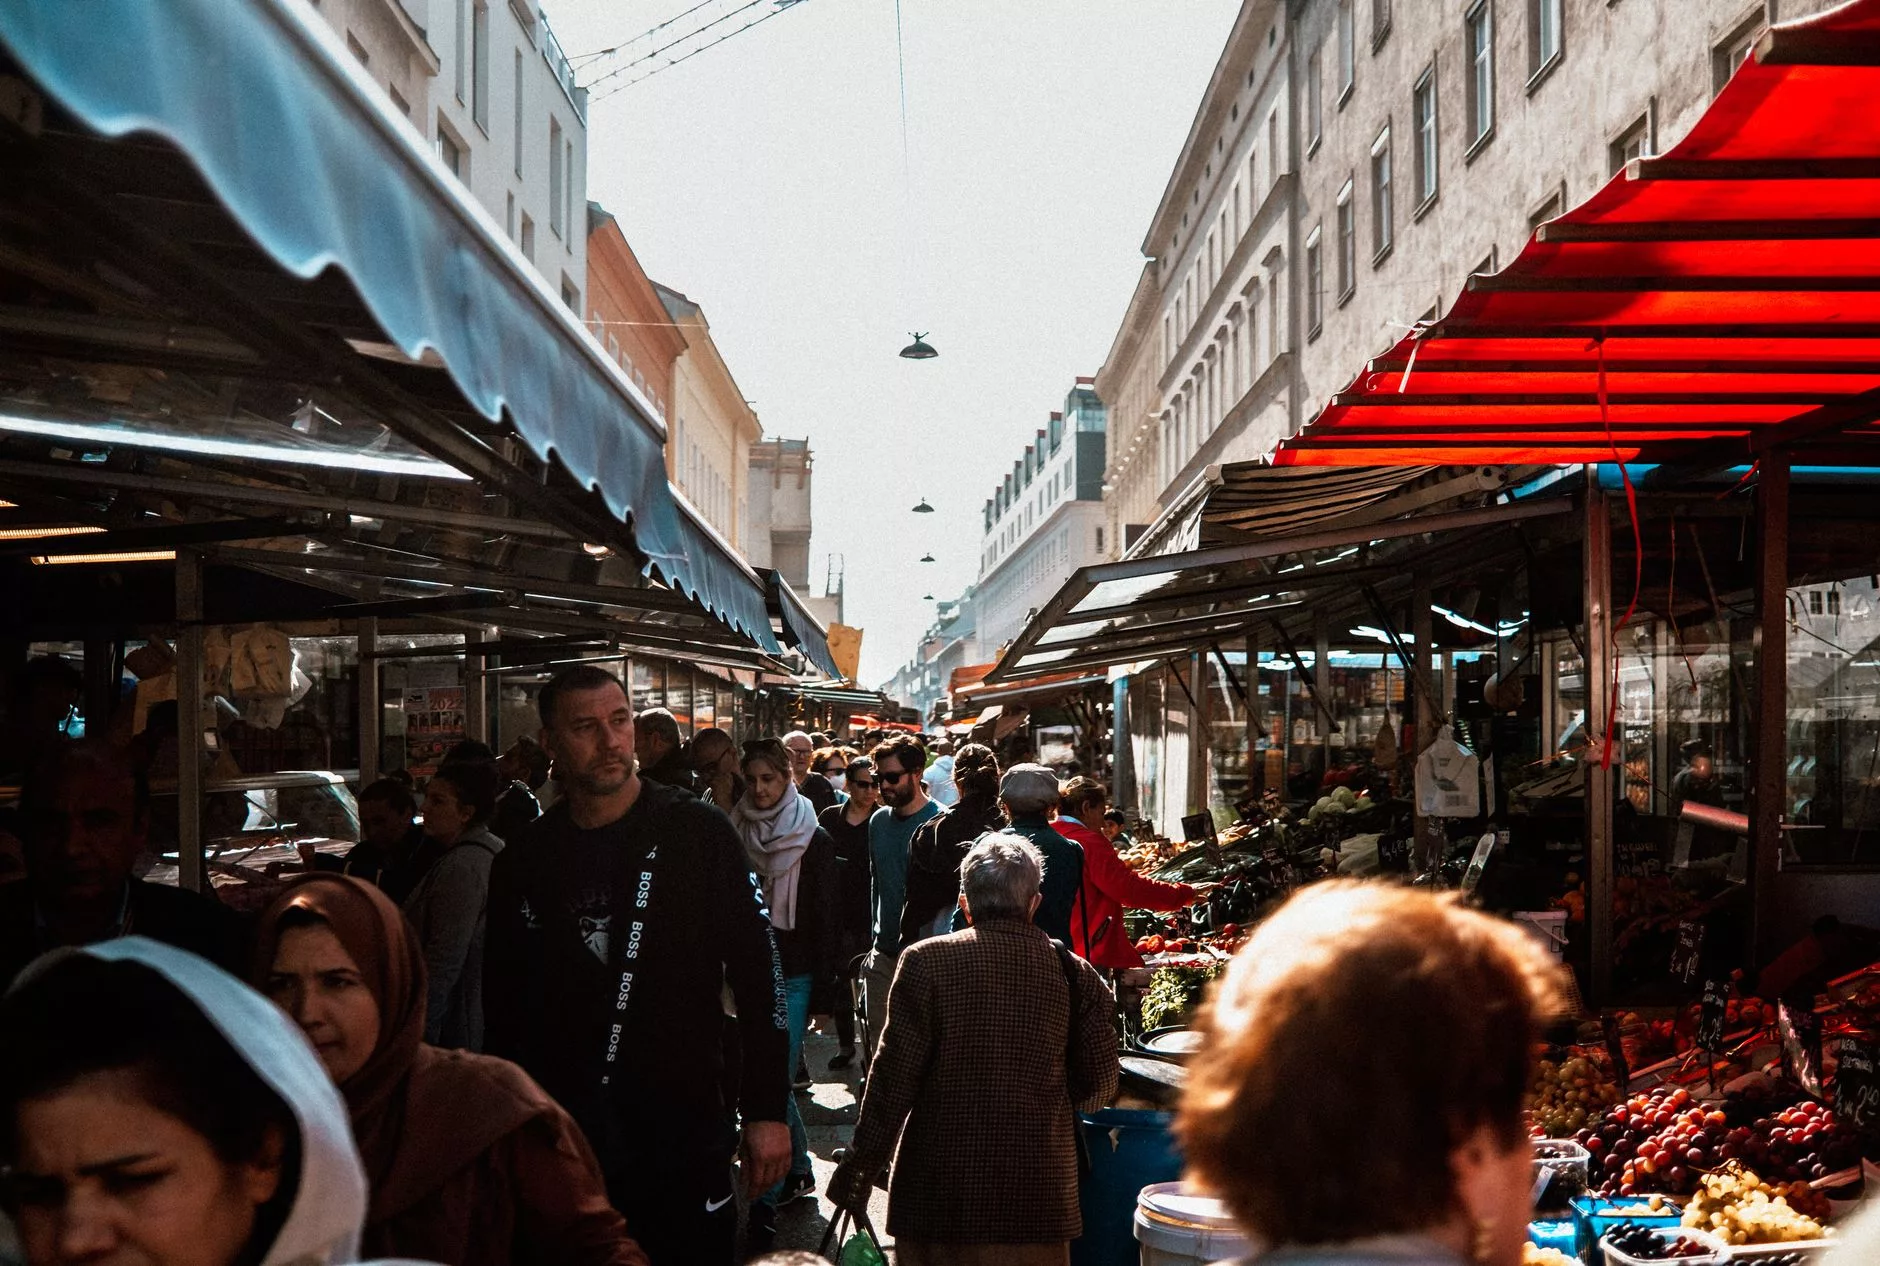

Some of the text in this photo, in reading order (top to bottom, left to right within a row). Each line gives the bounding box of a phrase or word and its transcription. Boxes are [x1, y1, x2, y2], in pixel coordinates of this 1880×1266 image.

[430, 698, 463, 711] 2022
[635, 872, 652, 908] BOSS
[626, 922, 643, 959] BOSS
[616, 973, 632, 1010] BOSS
[606, 1024, 621, 1062] BOSS
